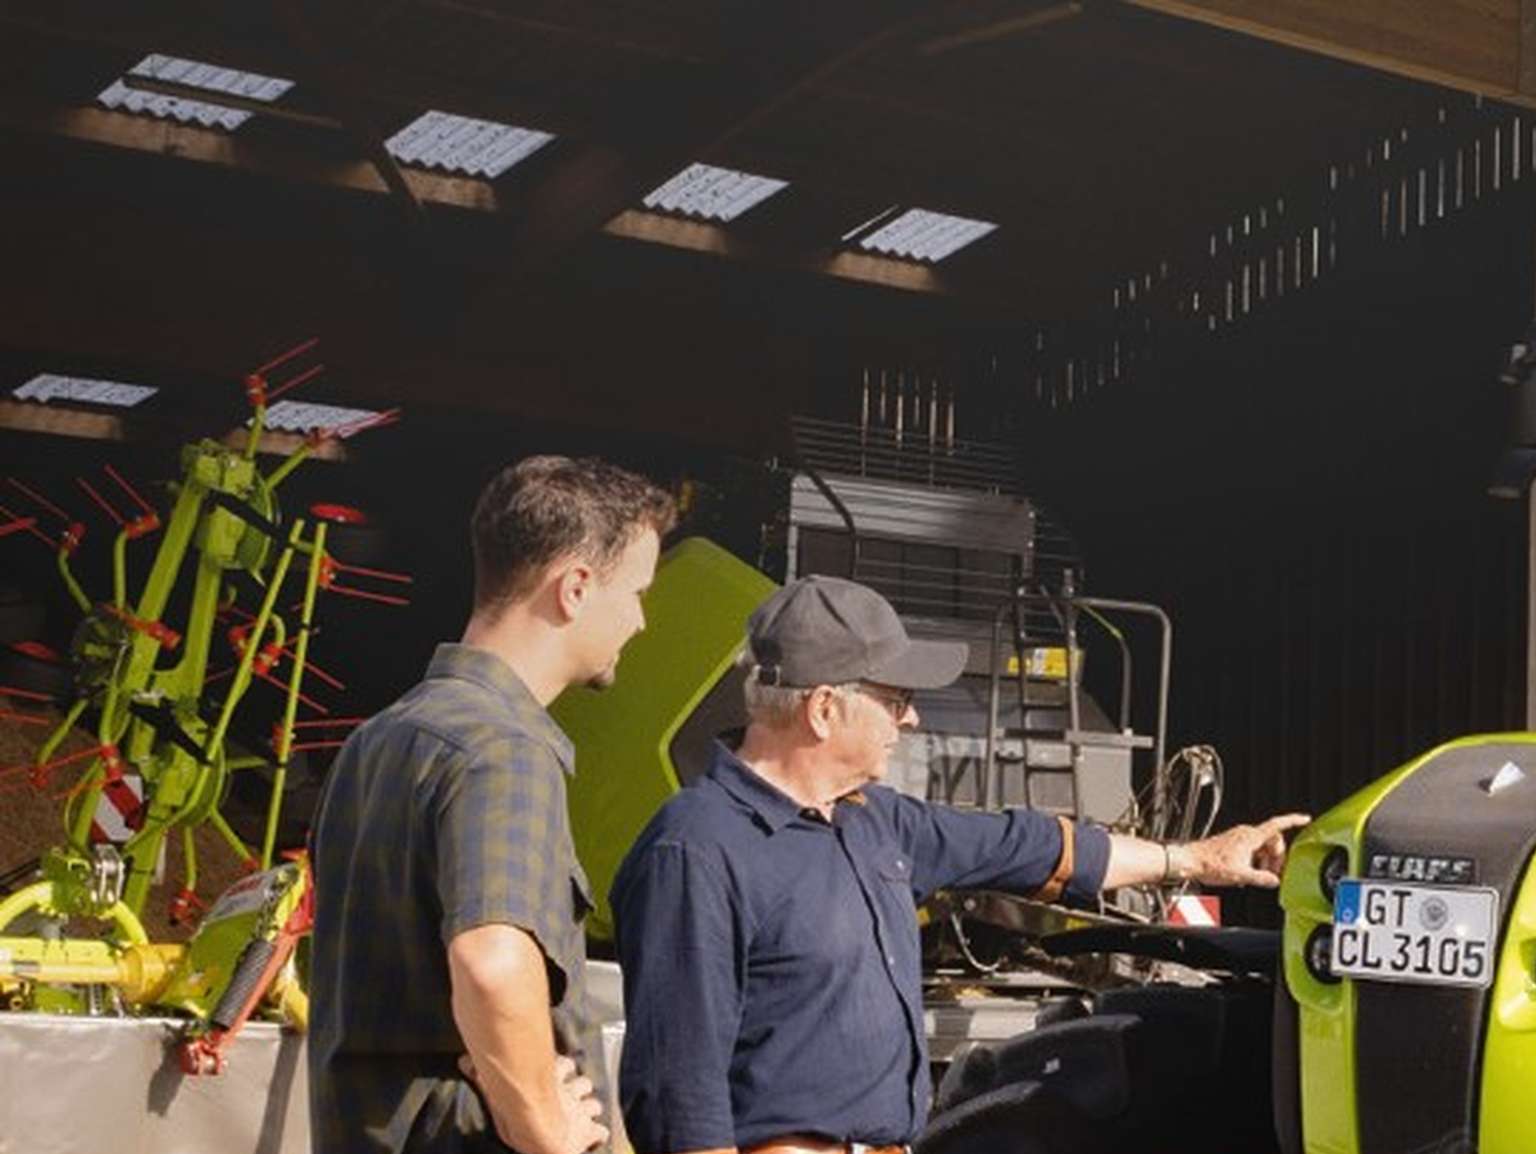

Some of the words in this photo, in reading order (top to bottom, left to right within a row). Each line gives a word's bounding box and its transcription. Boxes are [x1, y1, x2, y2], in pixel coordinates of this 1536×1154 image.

[1366, 888, 1412, 927] GT
[1338, 929, 1382, 968] CL
[1390, 934, 1485, 978] 3105
